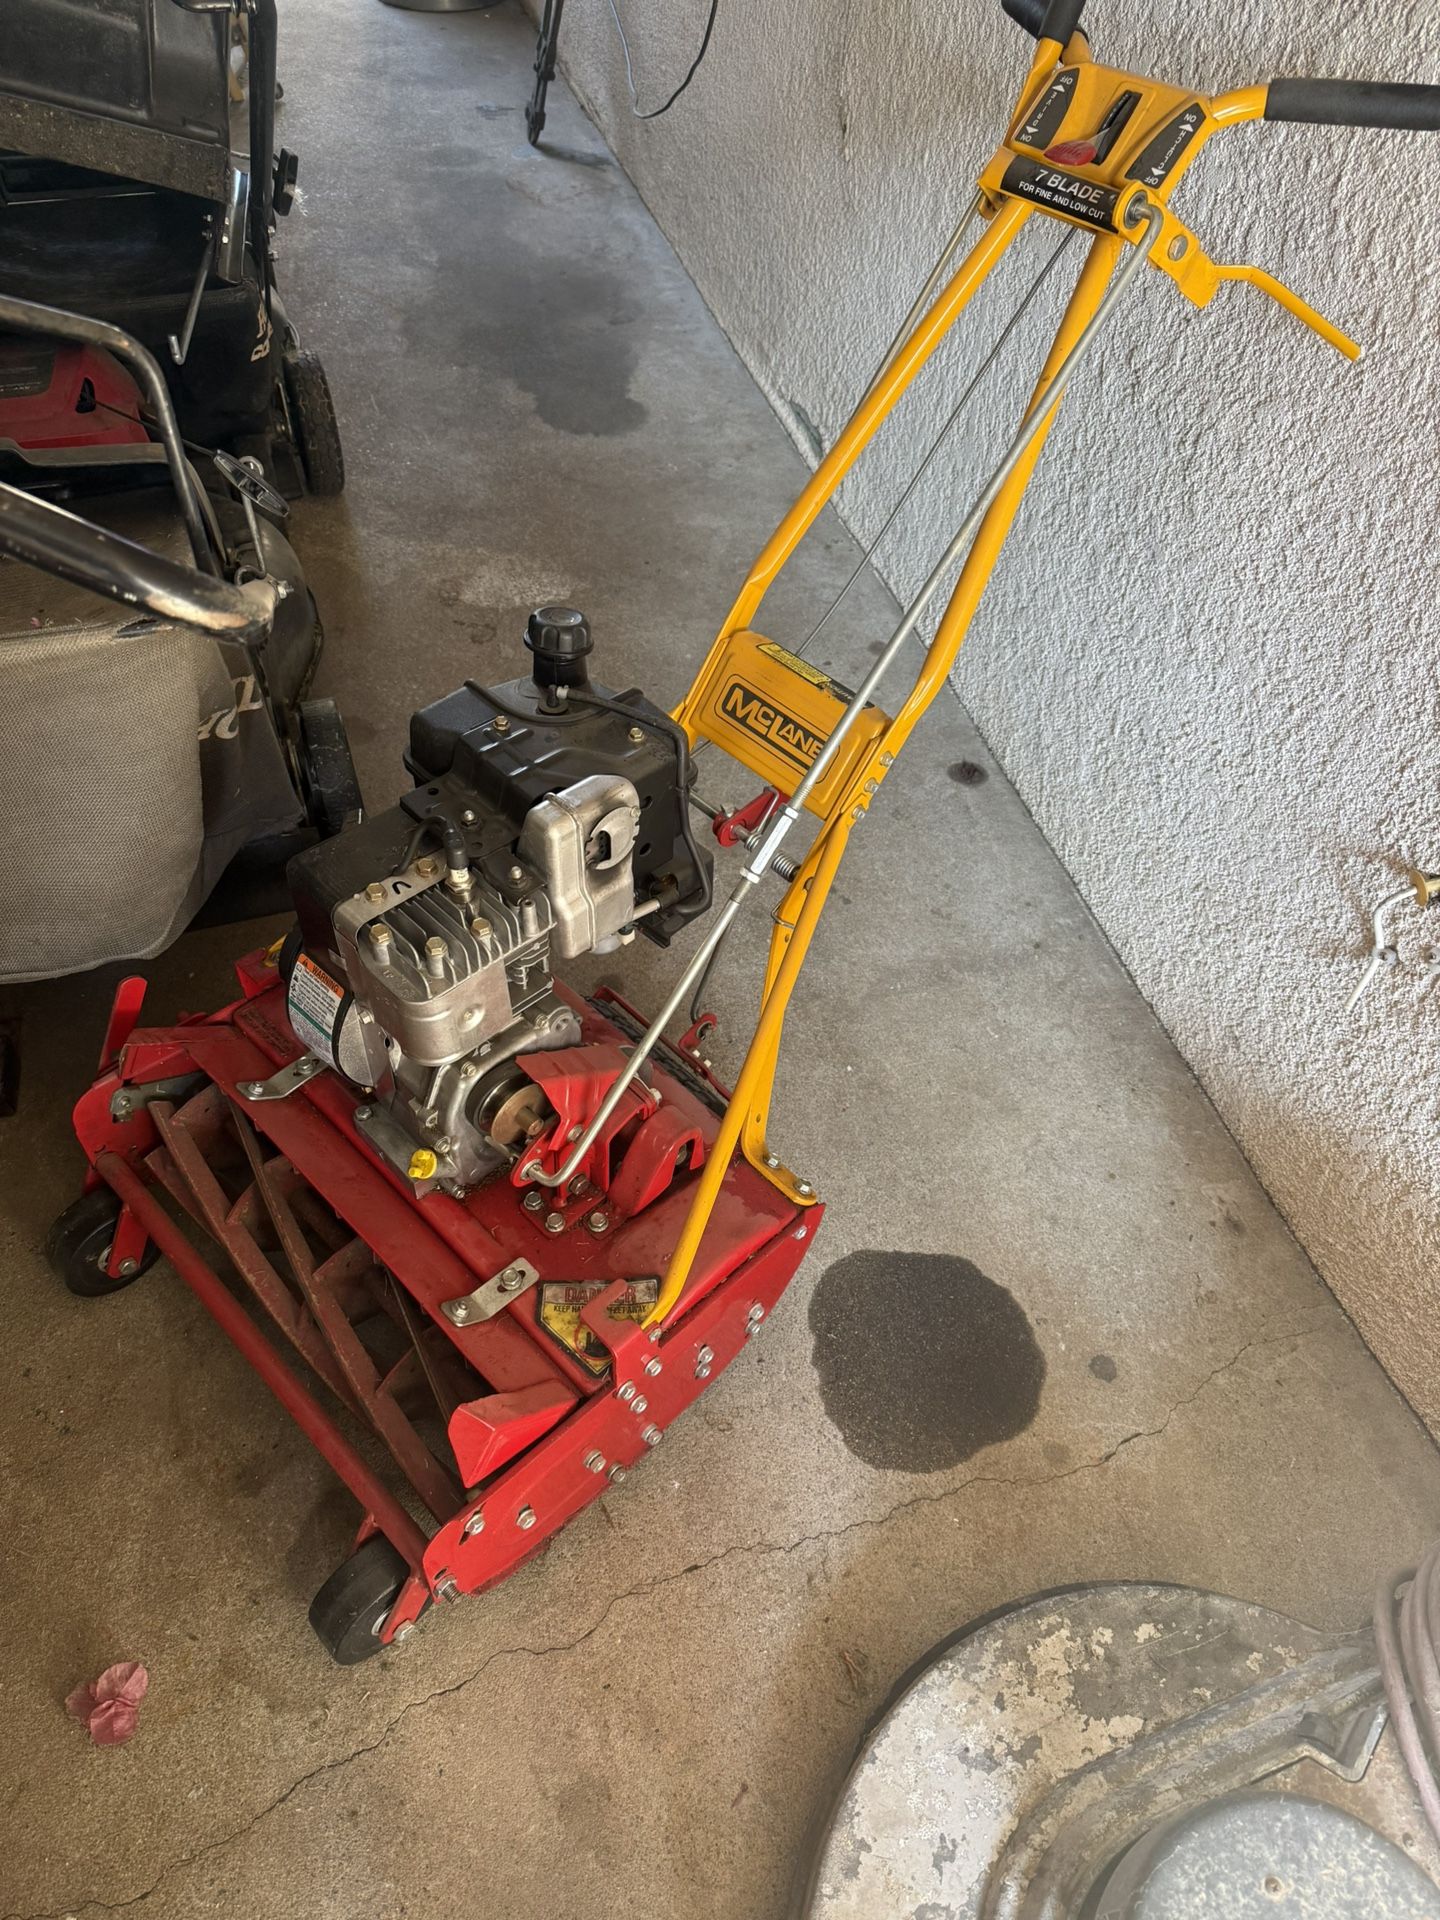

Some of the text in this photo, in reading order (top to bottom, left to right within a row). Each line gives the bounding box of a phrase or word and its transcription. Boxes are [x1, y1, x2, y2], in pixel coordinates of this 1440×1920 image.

[1060, 75, 1073, 85] OFF
[1032, 91, 1058, 126] DRIVE
[1183, 113, 1197, 123] ON
[1019, 133, 1032, 143] ON
[1157, 129, 1187, 169] CLUTCH
[1035, 169, 1104, 204] 7 BLADE
[1144, 175, 1159, 186] OFF
[1018, 181, 1105, 220] FOR FINE AND LOW CUT
[310, 964, 339, 994] WARNING
